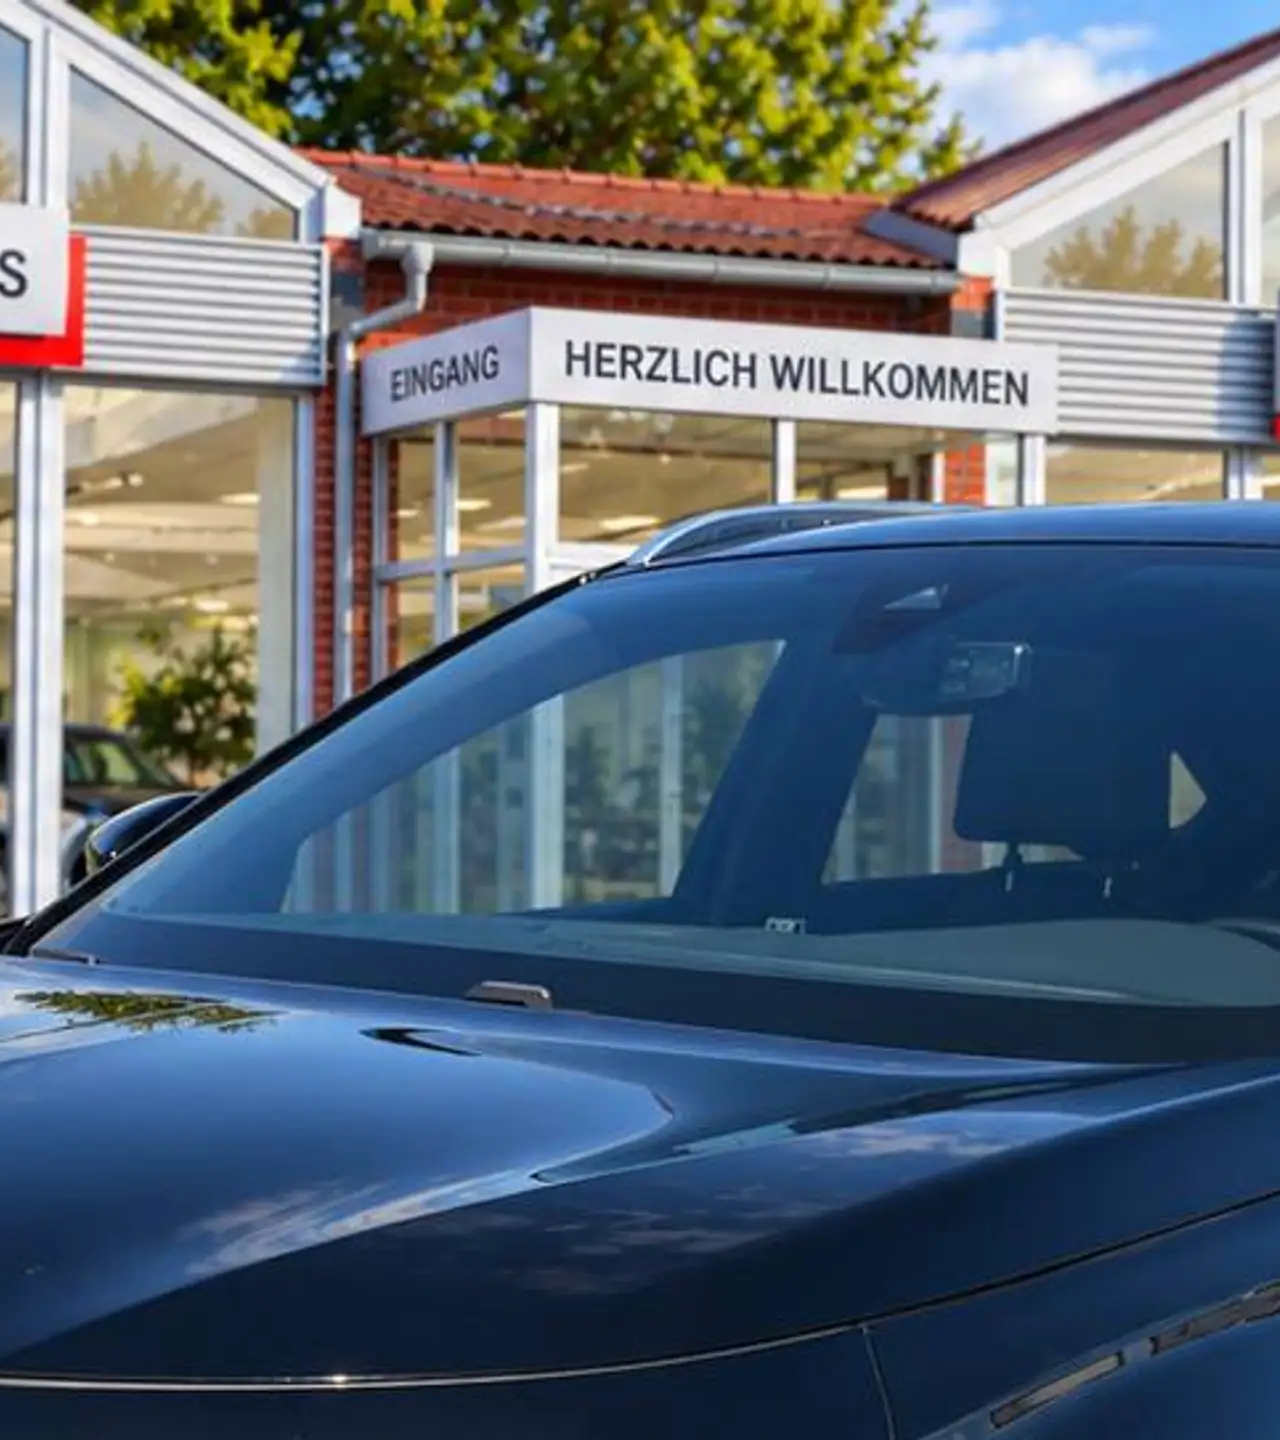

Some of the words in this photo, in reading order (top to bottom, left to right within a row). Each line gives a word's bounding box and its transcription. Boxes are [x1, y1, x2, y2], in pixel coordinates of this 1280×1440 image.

[389, 346, 501, 402] EINGANG
[564, 338, 758, 390] HERZLICH
[769, 353, 1029, 407] WILLKOMMEN
